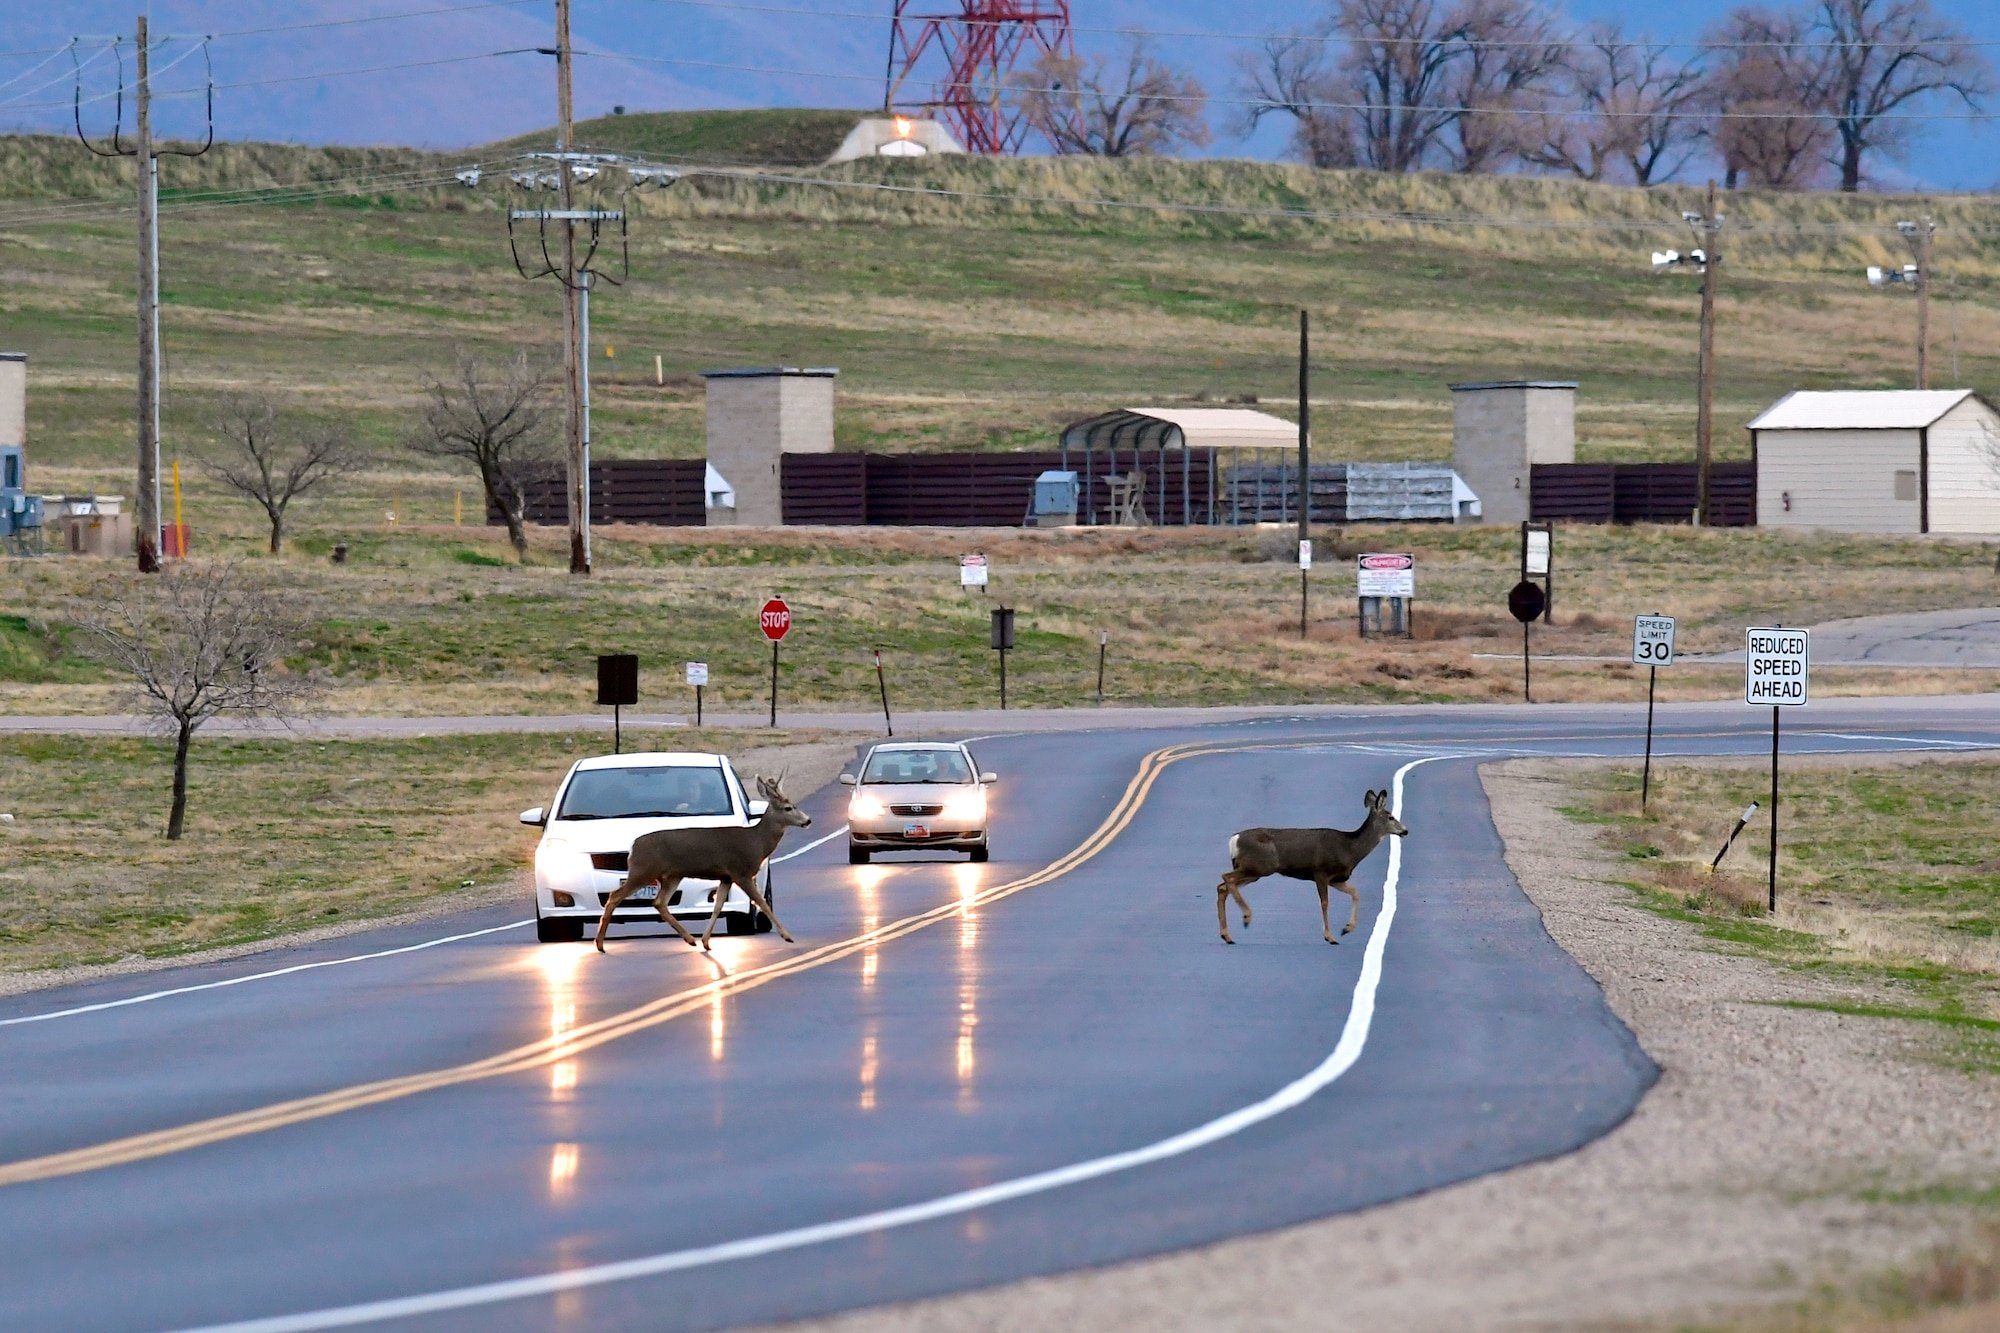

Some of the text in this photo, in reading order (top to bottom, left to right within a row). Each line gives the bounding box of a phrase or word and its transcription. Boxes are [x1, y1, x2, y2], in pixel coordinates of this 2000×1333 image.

[1514, 477, 1520, 489] 2
[762, 611, 789, 628] STOP
[1639, 620, 1672, 630] SPEED
[1641, 631, 1667, 639] LIMIT
[1638, 641, 1669, 661] 30
[1751, 637, 1804, 655] REDUCED
[1753, 658, 1801, 676] SPEED
[1752, 681, 1802, 698] AHEAD
